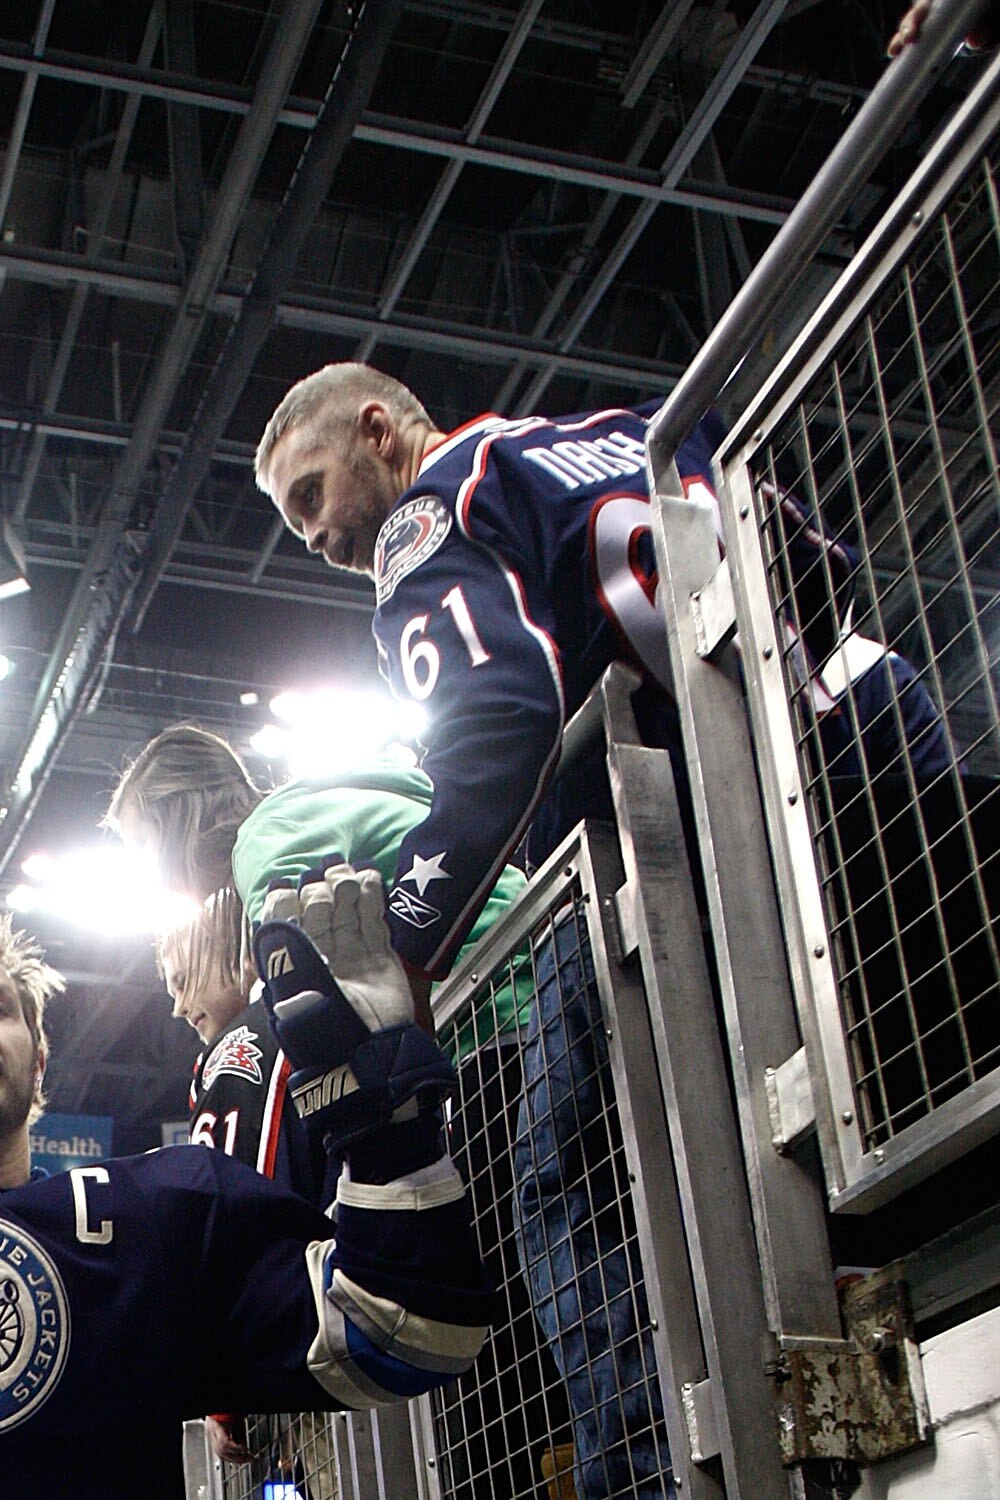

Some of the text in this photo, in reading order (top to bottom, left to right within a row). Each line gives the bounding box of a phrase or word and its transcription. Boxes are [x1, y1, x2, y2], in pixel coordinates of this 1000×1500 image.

[520, 431, 647, 490] NASH
[400, 584, 490, 701] 61
[30, 1135, 101, 1157] Health
[189, 1110, 239, 1157] 61
[70, 1166, 114, 1245] C
[12, 1272, 57, 1404] JACKETS
